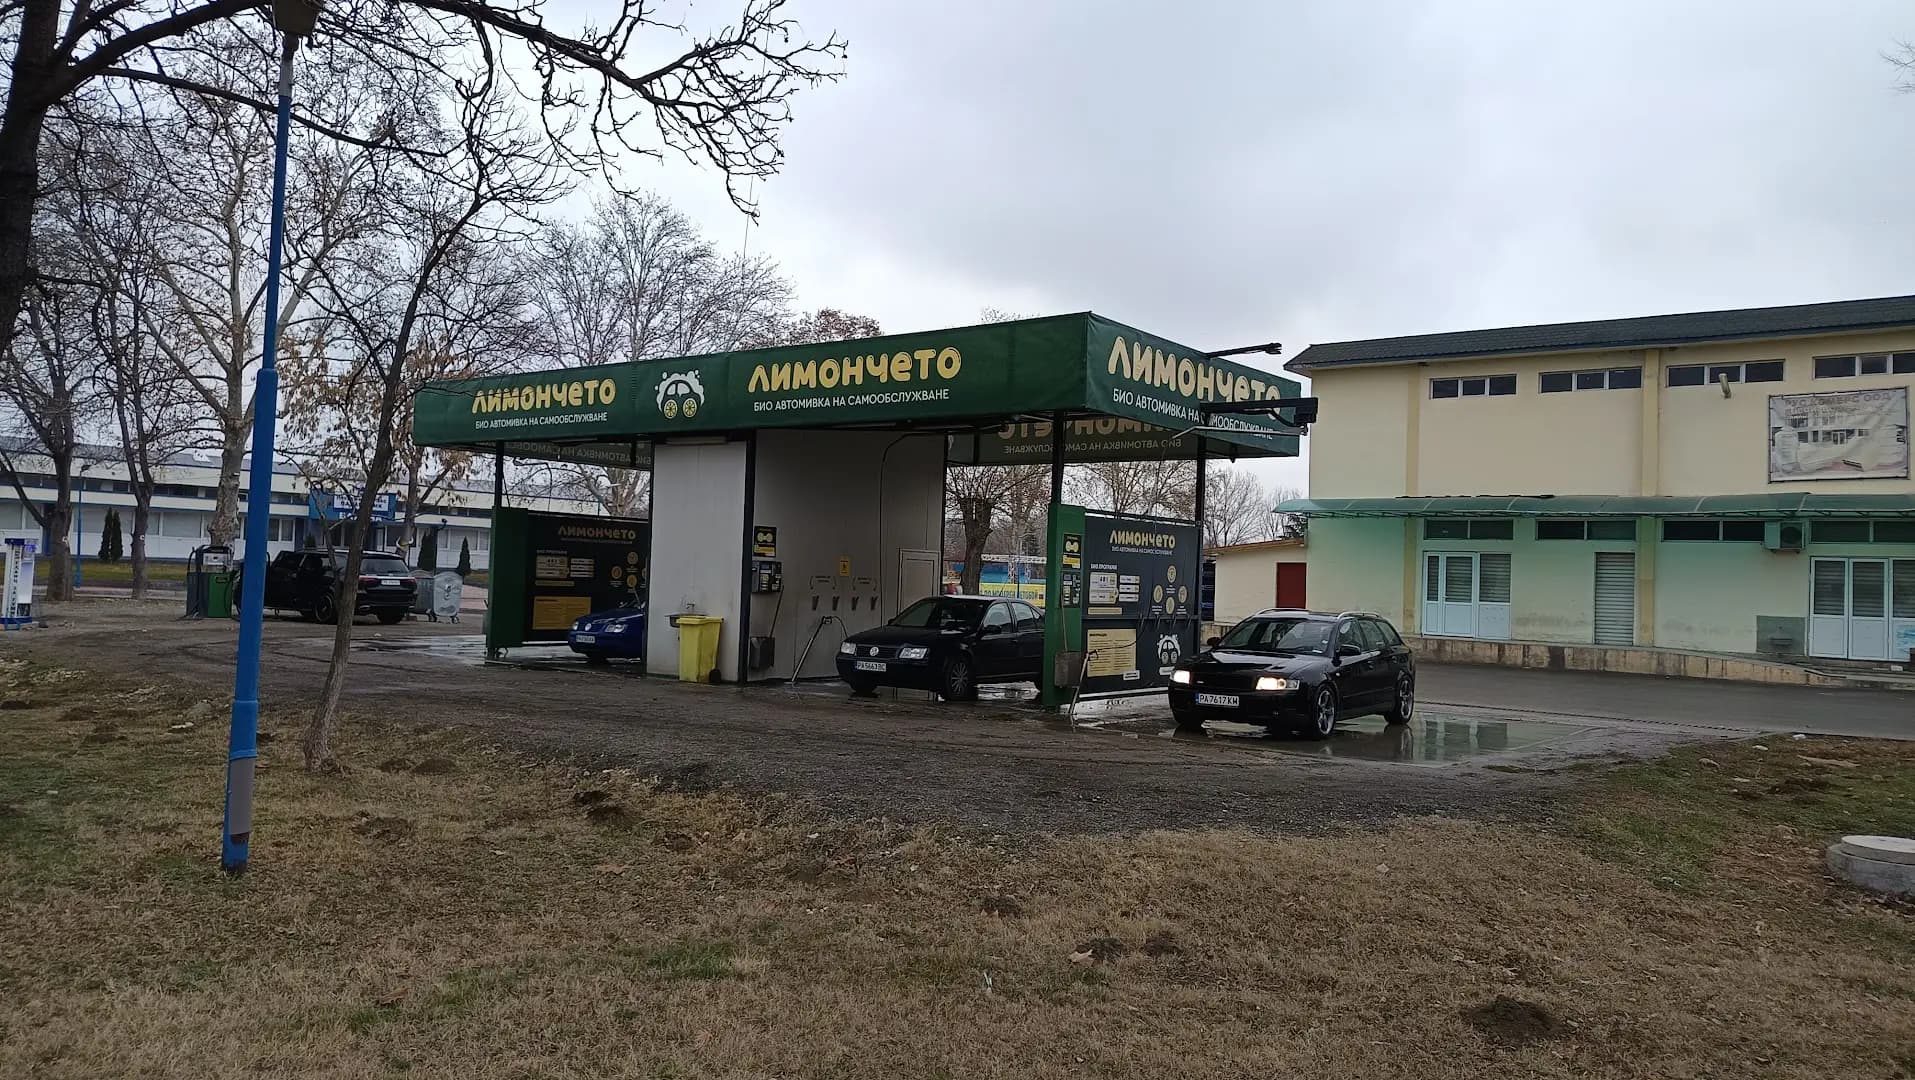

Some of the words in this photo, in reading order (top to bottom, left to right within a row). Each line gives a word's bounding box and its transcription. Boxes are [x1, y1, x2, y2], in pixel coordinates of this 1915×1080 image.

[753, 402, 773, 412] БИО
[775, 398, 831, 410] АВТОМИВКА
[832, 396, 846, 407] НА
[847, 388, 950, 406] САМООБСЛУЖВАНЕ
[1112, 388, 1133, 406] БИО
[1135, 394, 1187, 420] АВТОМИВКА
[1187, 409, 1200, 422] НА
[475, 420, 489, 430] БИО
[490, 418, 528, 429] АВТОМИВКА
[528, 416, 539, 426] НА
[539, 412, 608, 426] САМООБСЛУЖВАНЕ
